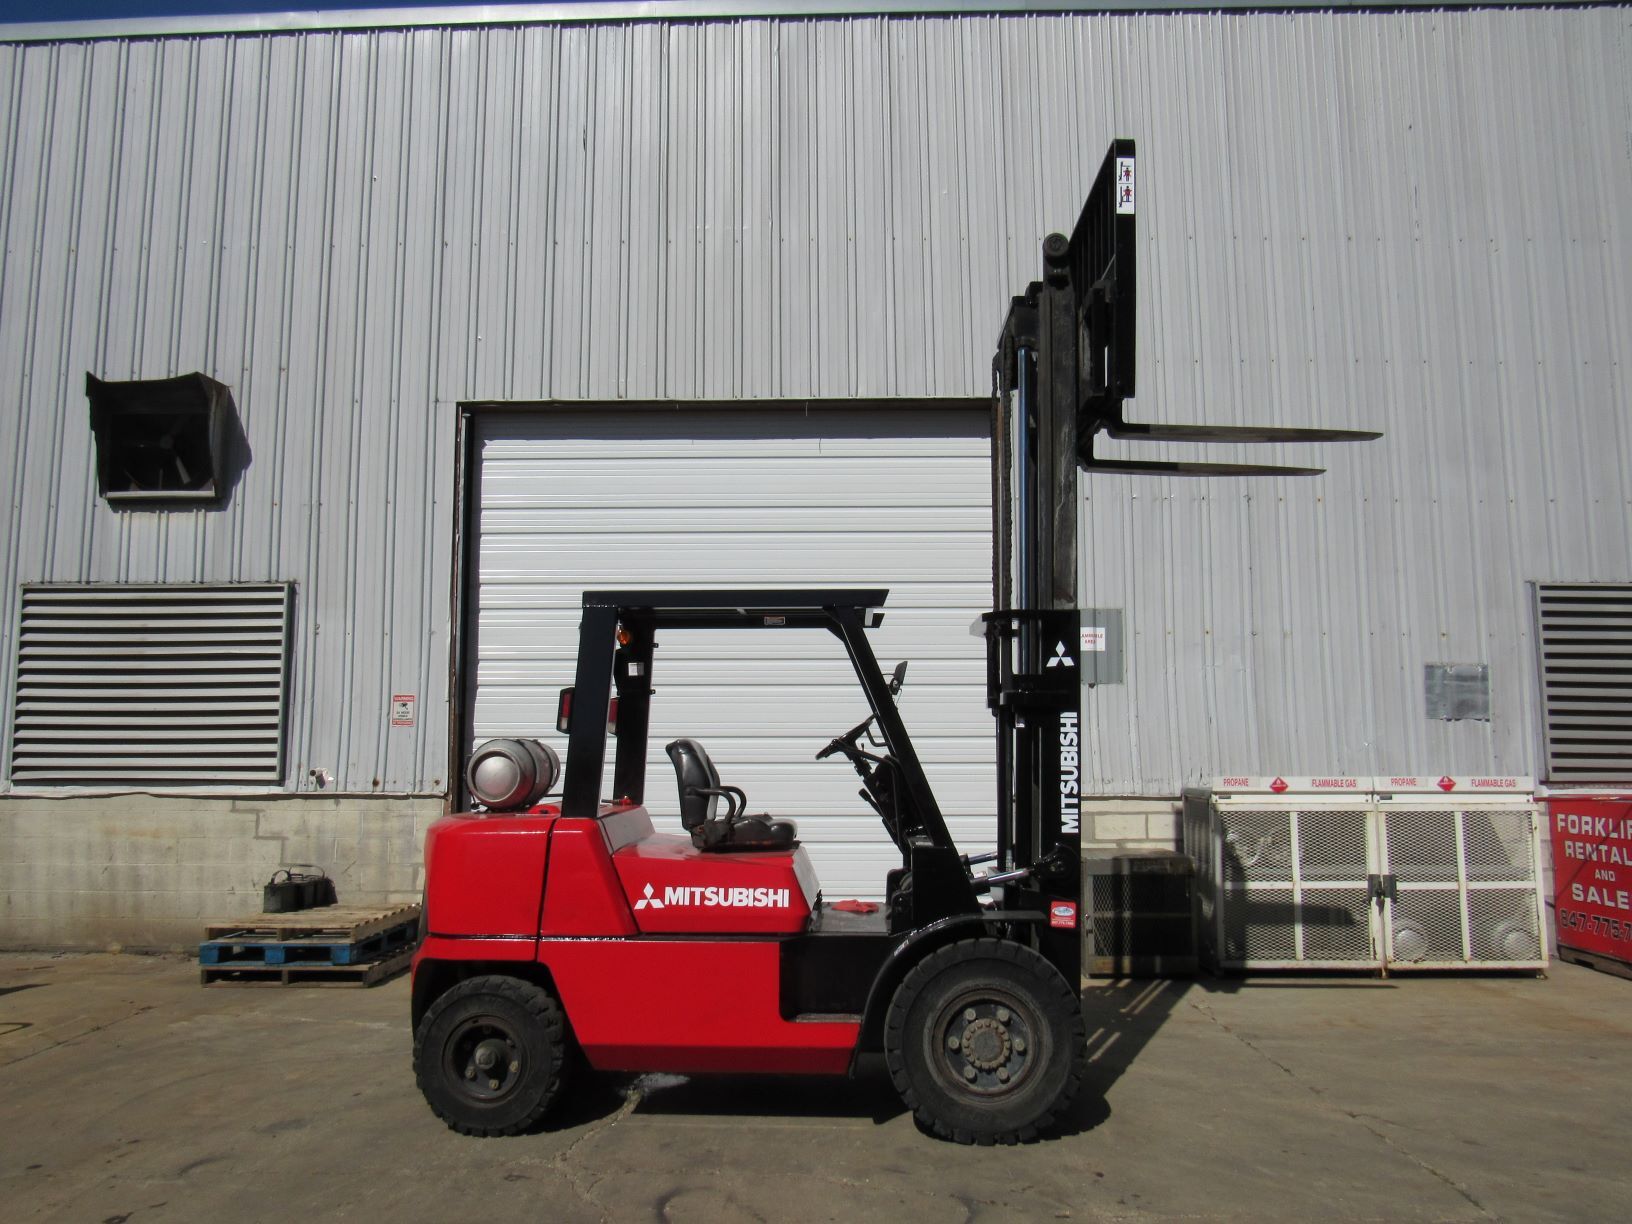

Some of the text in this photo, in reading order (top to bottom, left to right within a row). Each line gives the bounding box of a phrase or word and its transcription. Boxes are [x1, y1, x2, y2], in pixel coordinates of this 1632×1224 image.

[1060, 711, 1079, 834] MITSUBISHI
[1223, 778, 1249, 787] PROPANE
[1311, 778, 1357, 788] FLAMMABLE GAS
[1390, 777, 1417, 786] PROPANE
[1471, 778, 1516, 788] FLAMMABLE GAS
[1564, 840, 1632, 866] RENTAL
[1594, 869, 1616, 882] AND
[664, 886, 790, 908] MITSUBISHI
[1571, 883, 1630, 910] SALE
